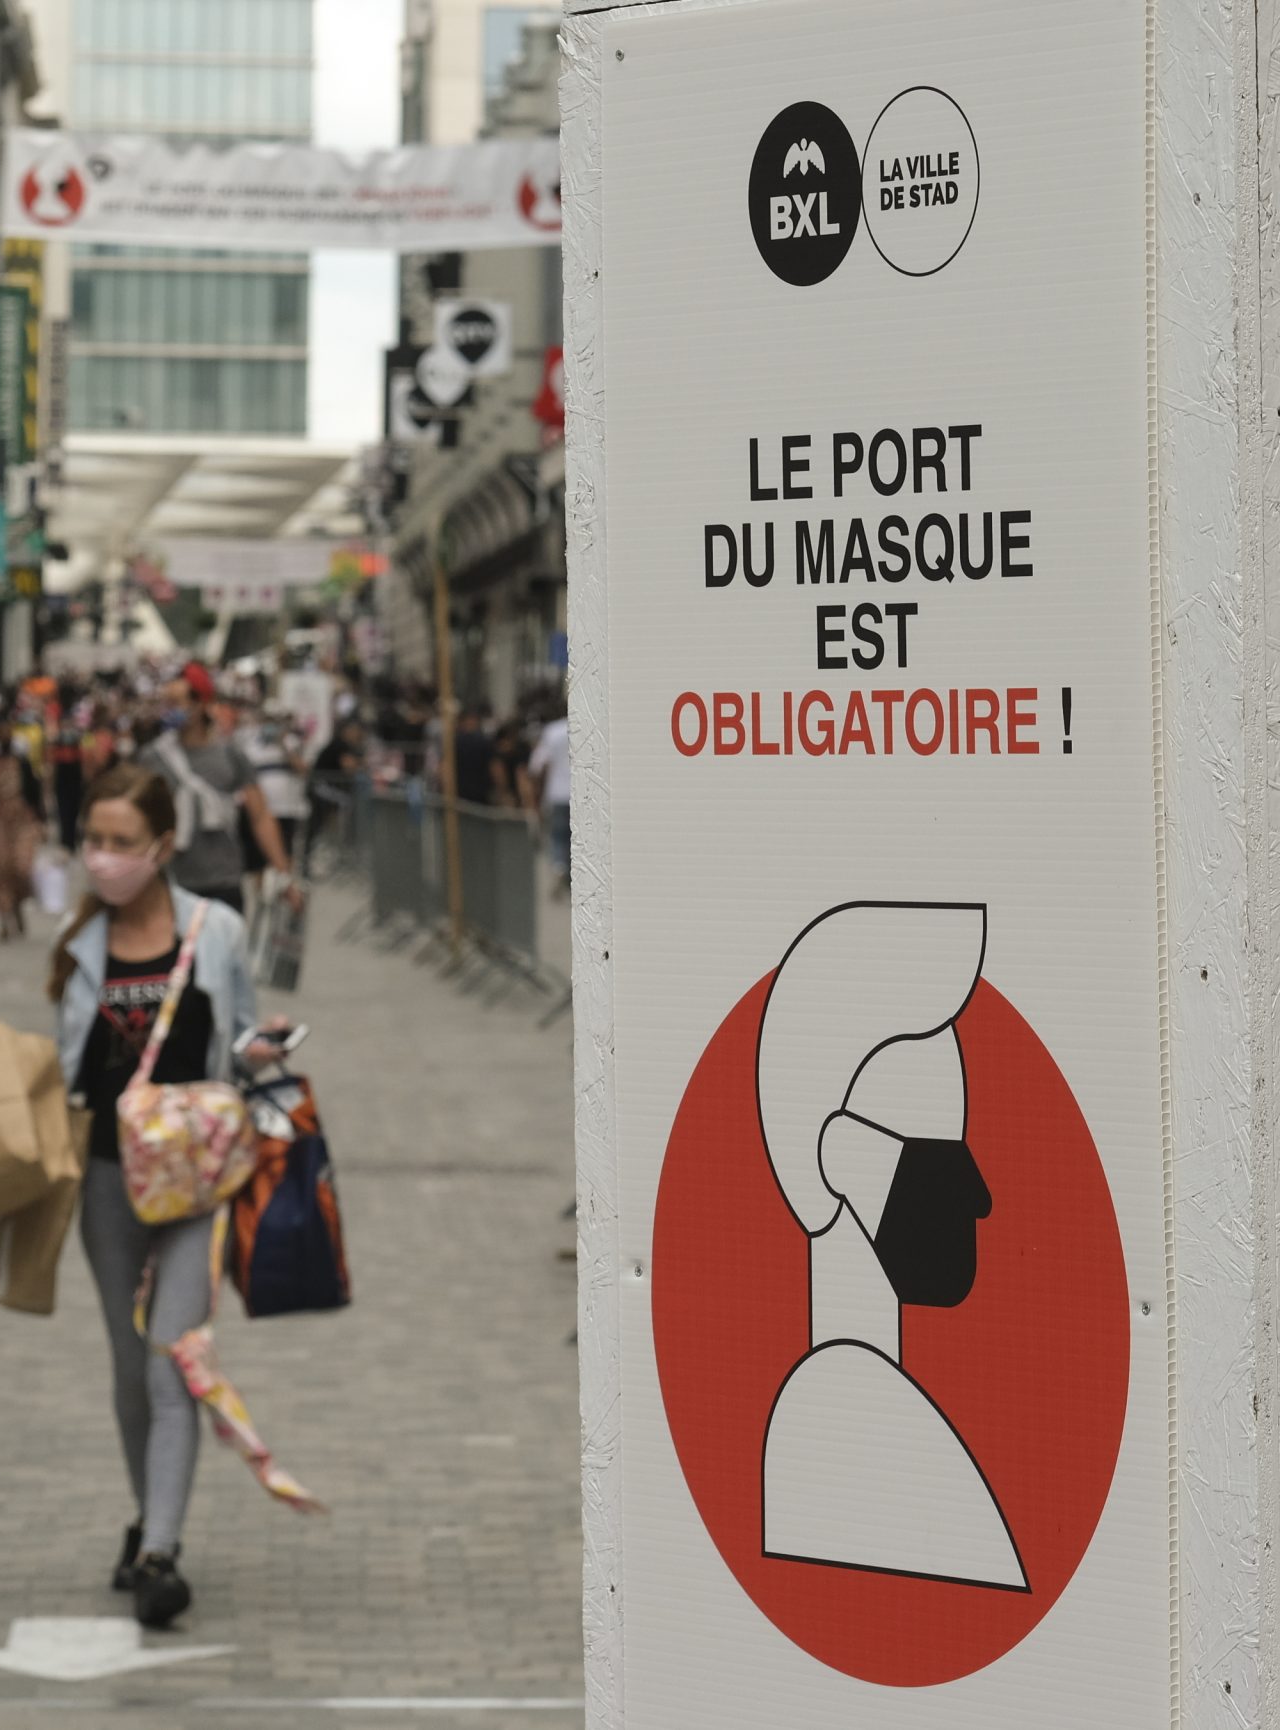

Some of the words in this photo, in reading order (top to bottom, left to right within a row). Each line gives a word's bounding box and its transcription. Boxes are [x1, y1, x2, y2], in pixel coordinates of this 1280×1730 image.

[879, 157, 904, 183] LA
[905, 151, 960, 180] VILLE
[880, 185, 905, 211] DE
[909, 180, 959, 209] STAD
[769, 191, 840, 241] BXL
[749, 434, 813, 502] LE
[832, 423, 983, 498] PORT
[704, 521, 775, 588] DU
[795, 510, 1034, 585] MASQUE
[816, 602, 919, 671] EST
[671, 687, 1040, 757] OBLIGATOIRE
